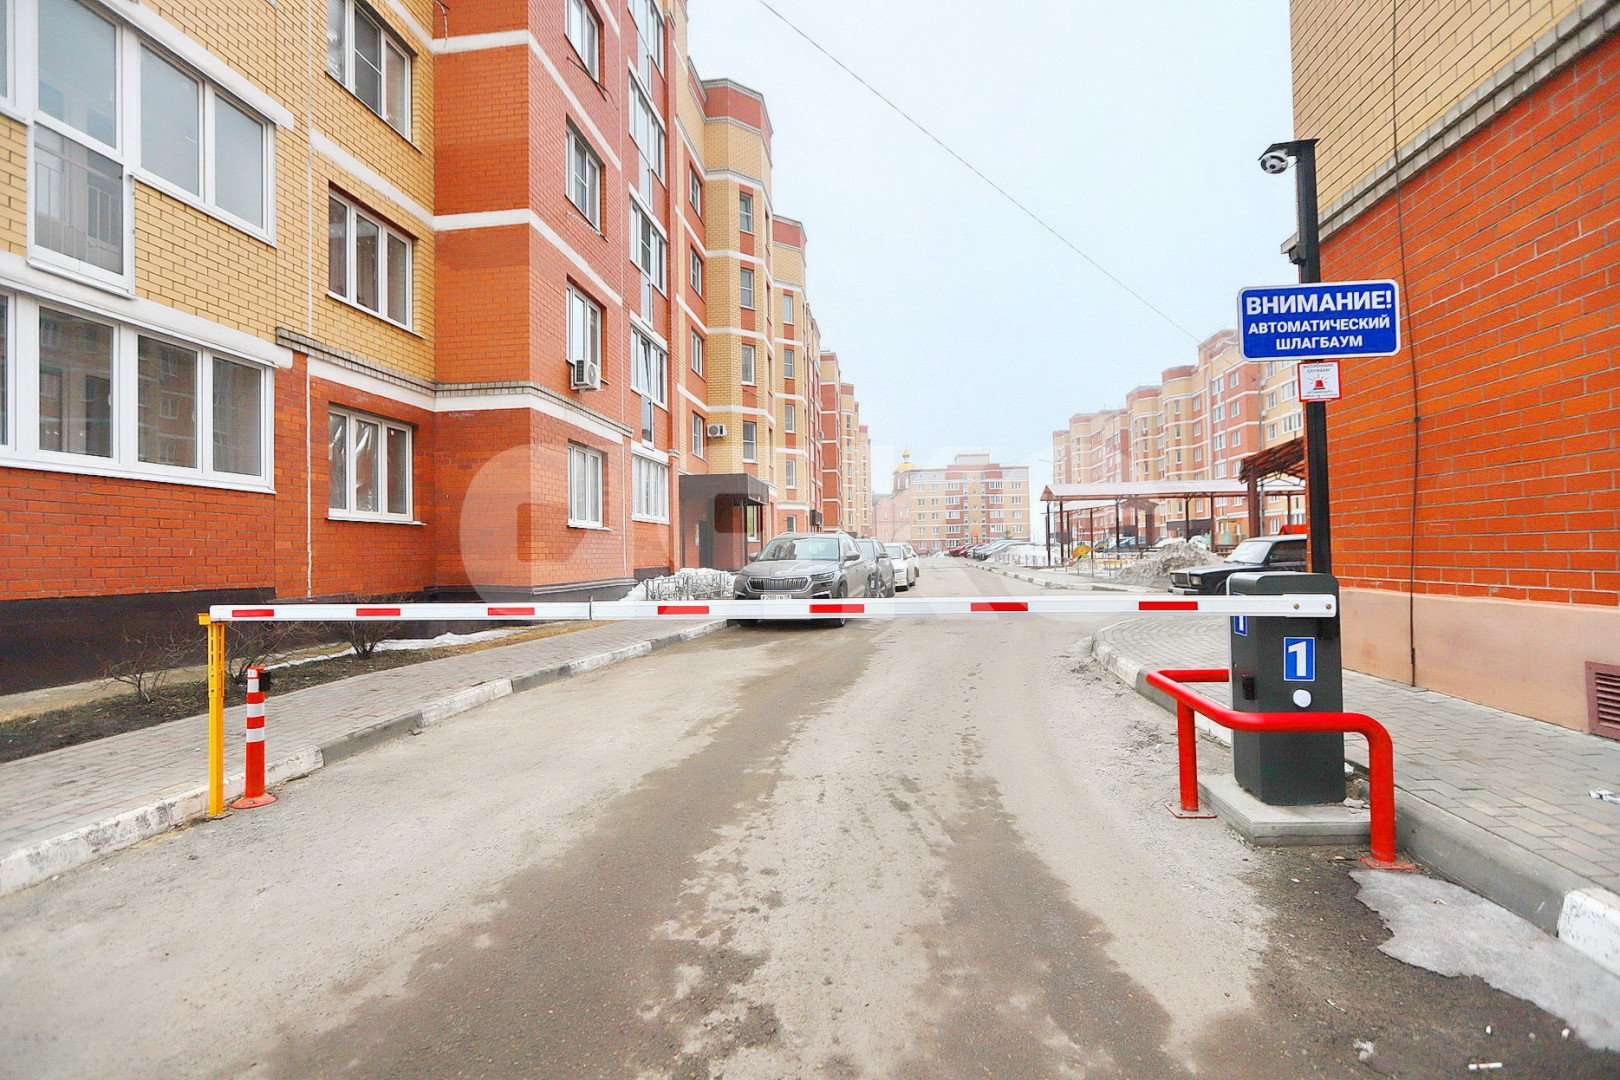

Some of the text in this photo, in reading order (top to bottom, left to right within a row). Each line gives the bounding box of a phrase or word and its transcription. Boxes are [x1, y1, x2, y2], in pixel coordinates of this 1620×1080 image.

[1246, 290, 1392, 315] ВНИМАНИЕ!
[1248, 314, 1390, 334] АВТОМАТИЧЕСКИЙ
[1276, 335, 1363, 350] ШЛАГБАУМ
[1288, 641, 1307, 677] 1
